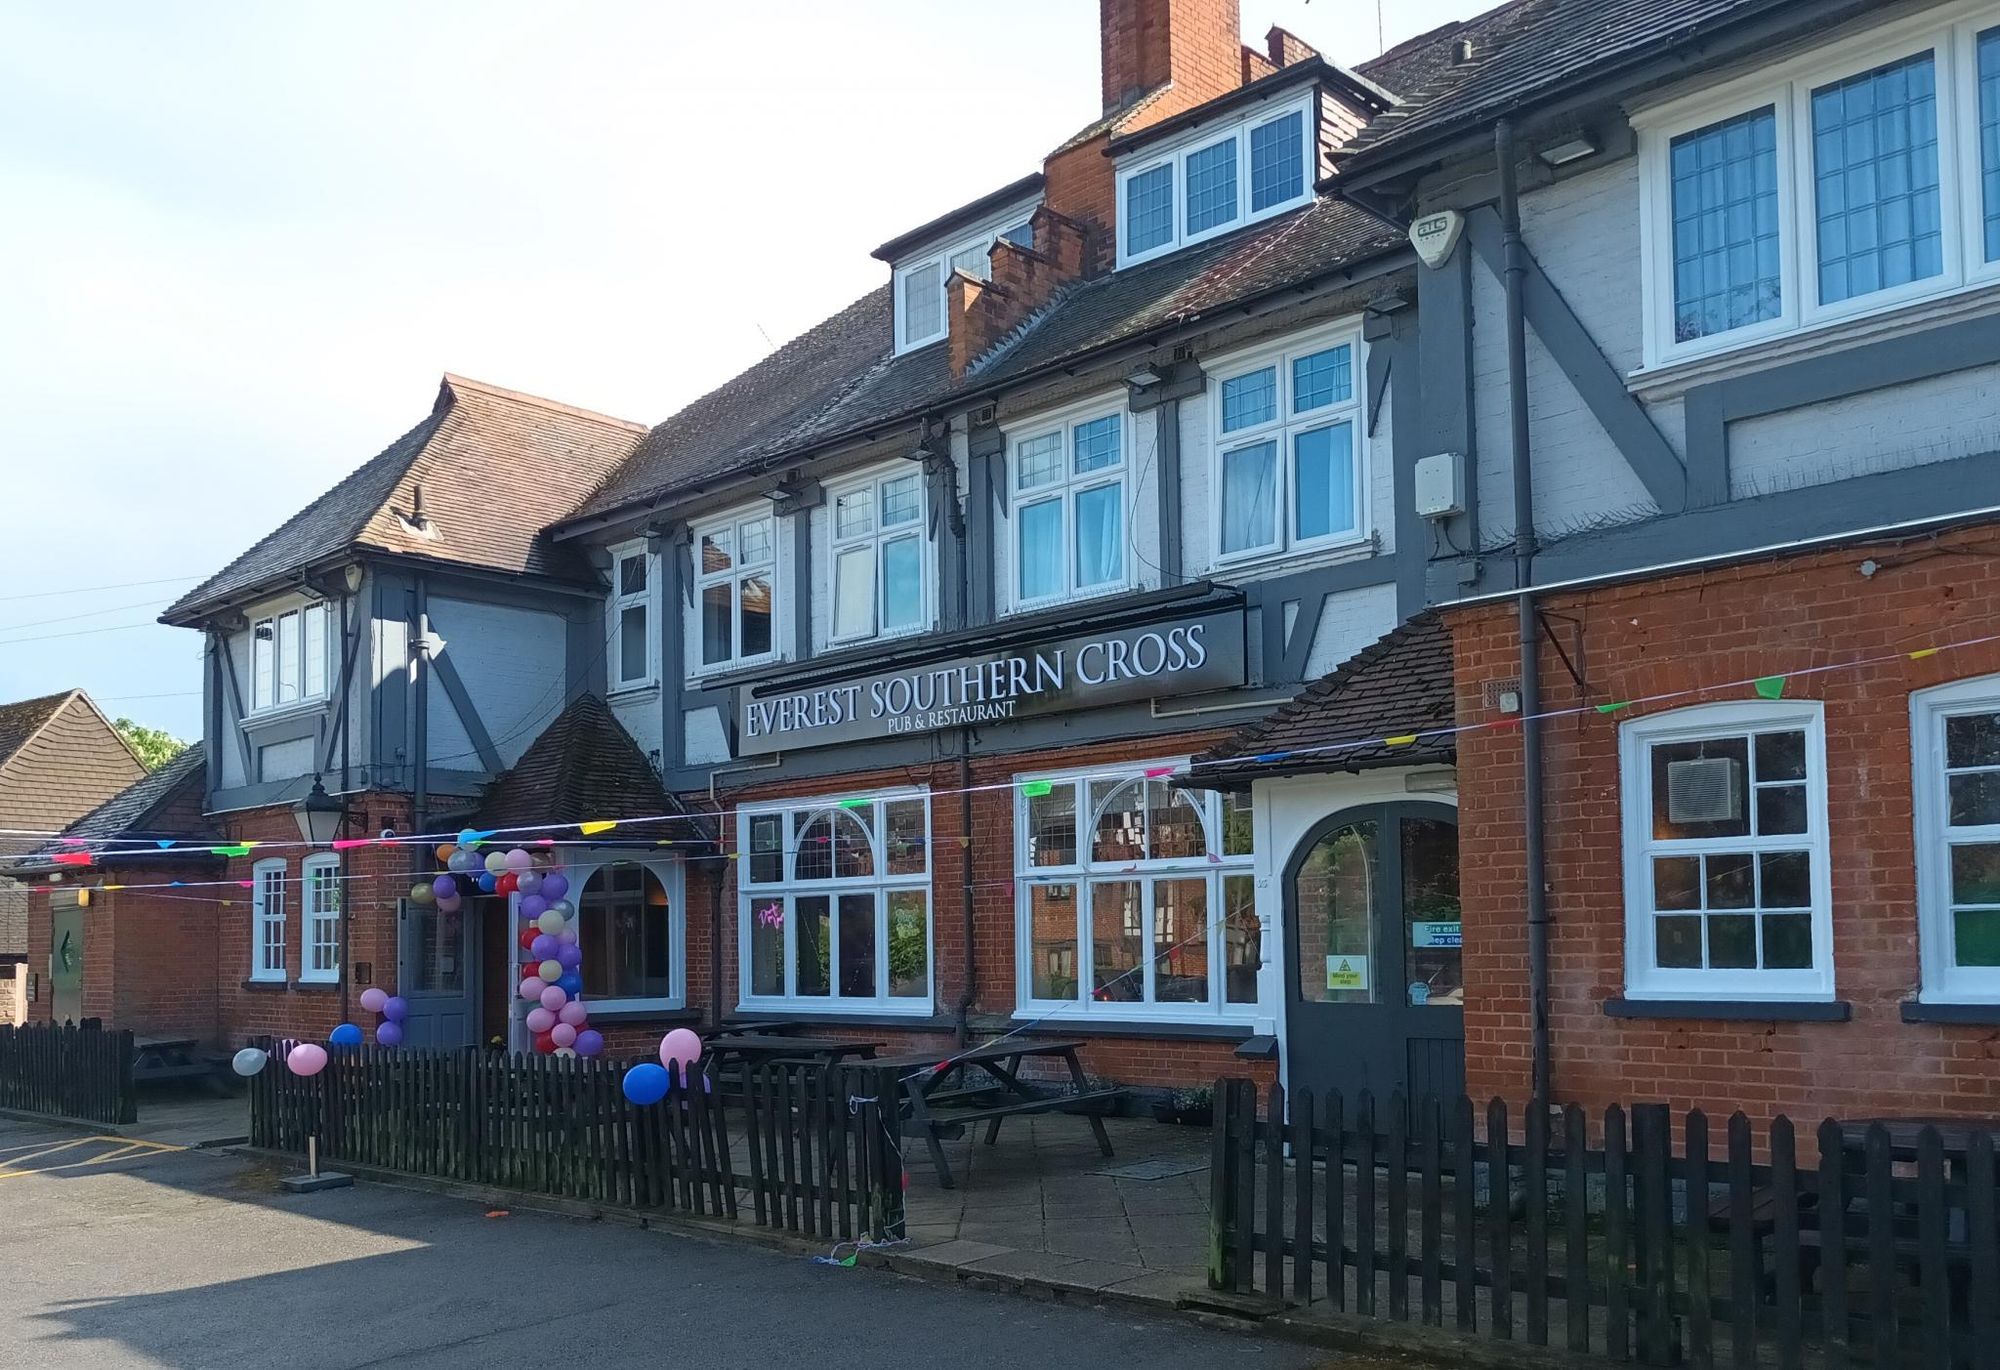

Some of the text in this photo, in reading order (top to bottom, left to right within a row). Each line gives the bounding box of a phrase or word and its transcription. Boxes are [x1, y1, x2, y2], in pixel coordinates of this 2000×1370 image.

[746, 624, 1207, 737] EVEREST SOUTHERN CROSS
[888, 700, 1016, 733] PUB & RESTAURANT
[1424, 925, 1459, 933] Fire exit
